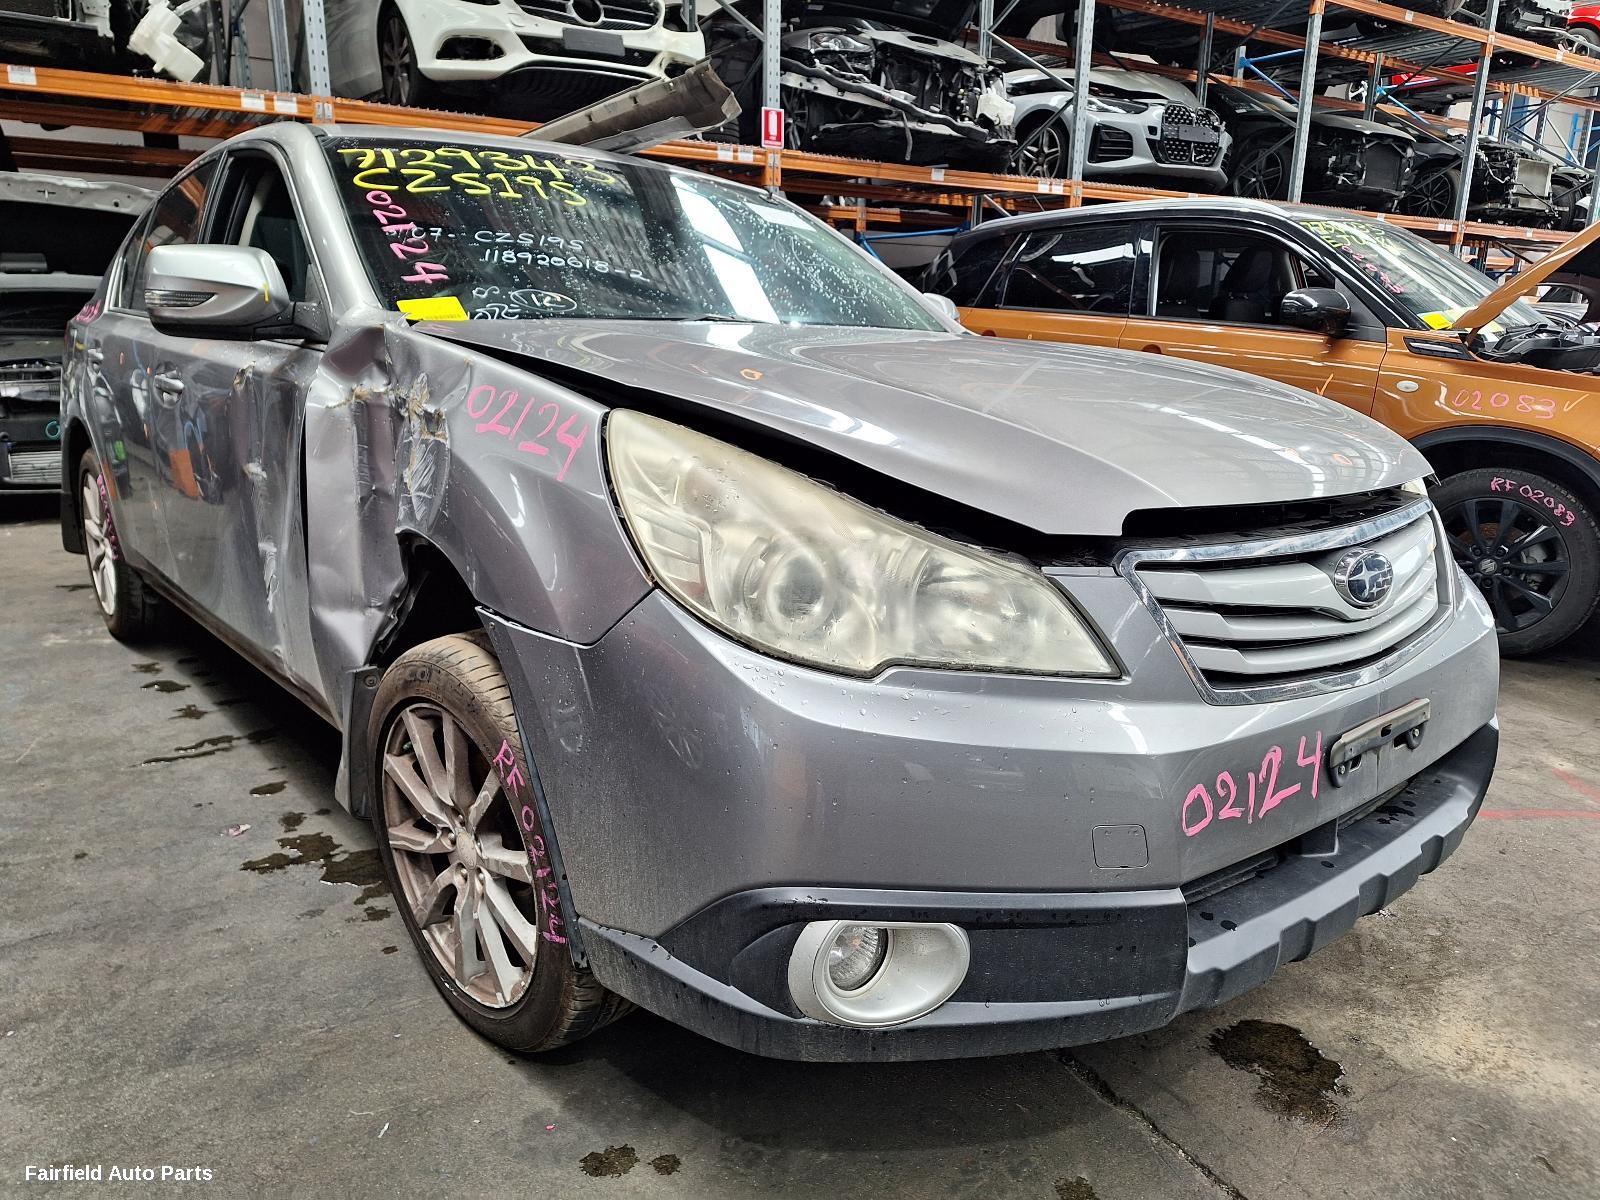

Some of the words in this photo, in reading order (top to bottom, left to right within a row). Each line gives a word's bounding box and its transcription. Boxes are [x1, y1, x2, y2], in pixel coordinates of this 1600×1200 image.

[366, 190, 449, 284] 02124
[467, 384, 590, 482] 02124
[1451, 389, 1556, 419] 02083
[1490, 477, 1517, 492] RF
[1519, 485, 1575, 526] 02083
[1182, 730, 1322, 837] 02124
[493, 739, 526, 798] RF
[521, 805, 568, 945] 02124
